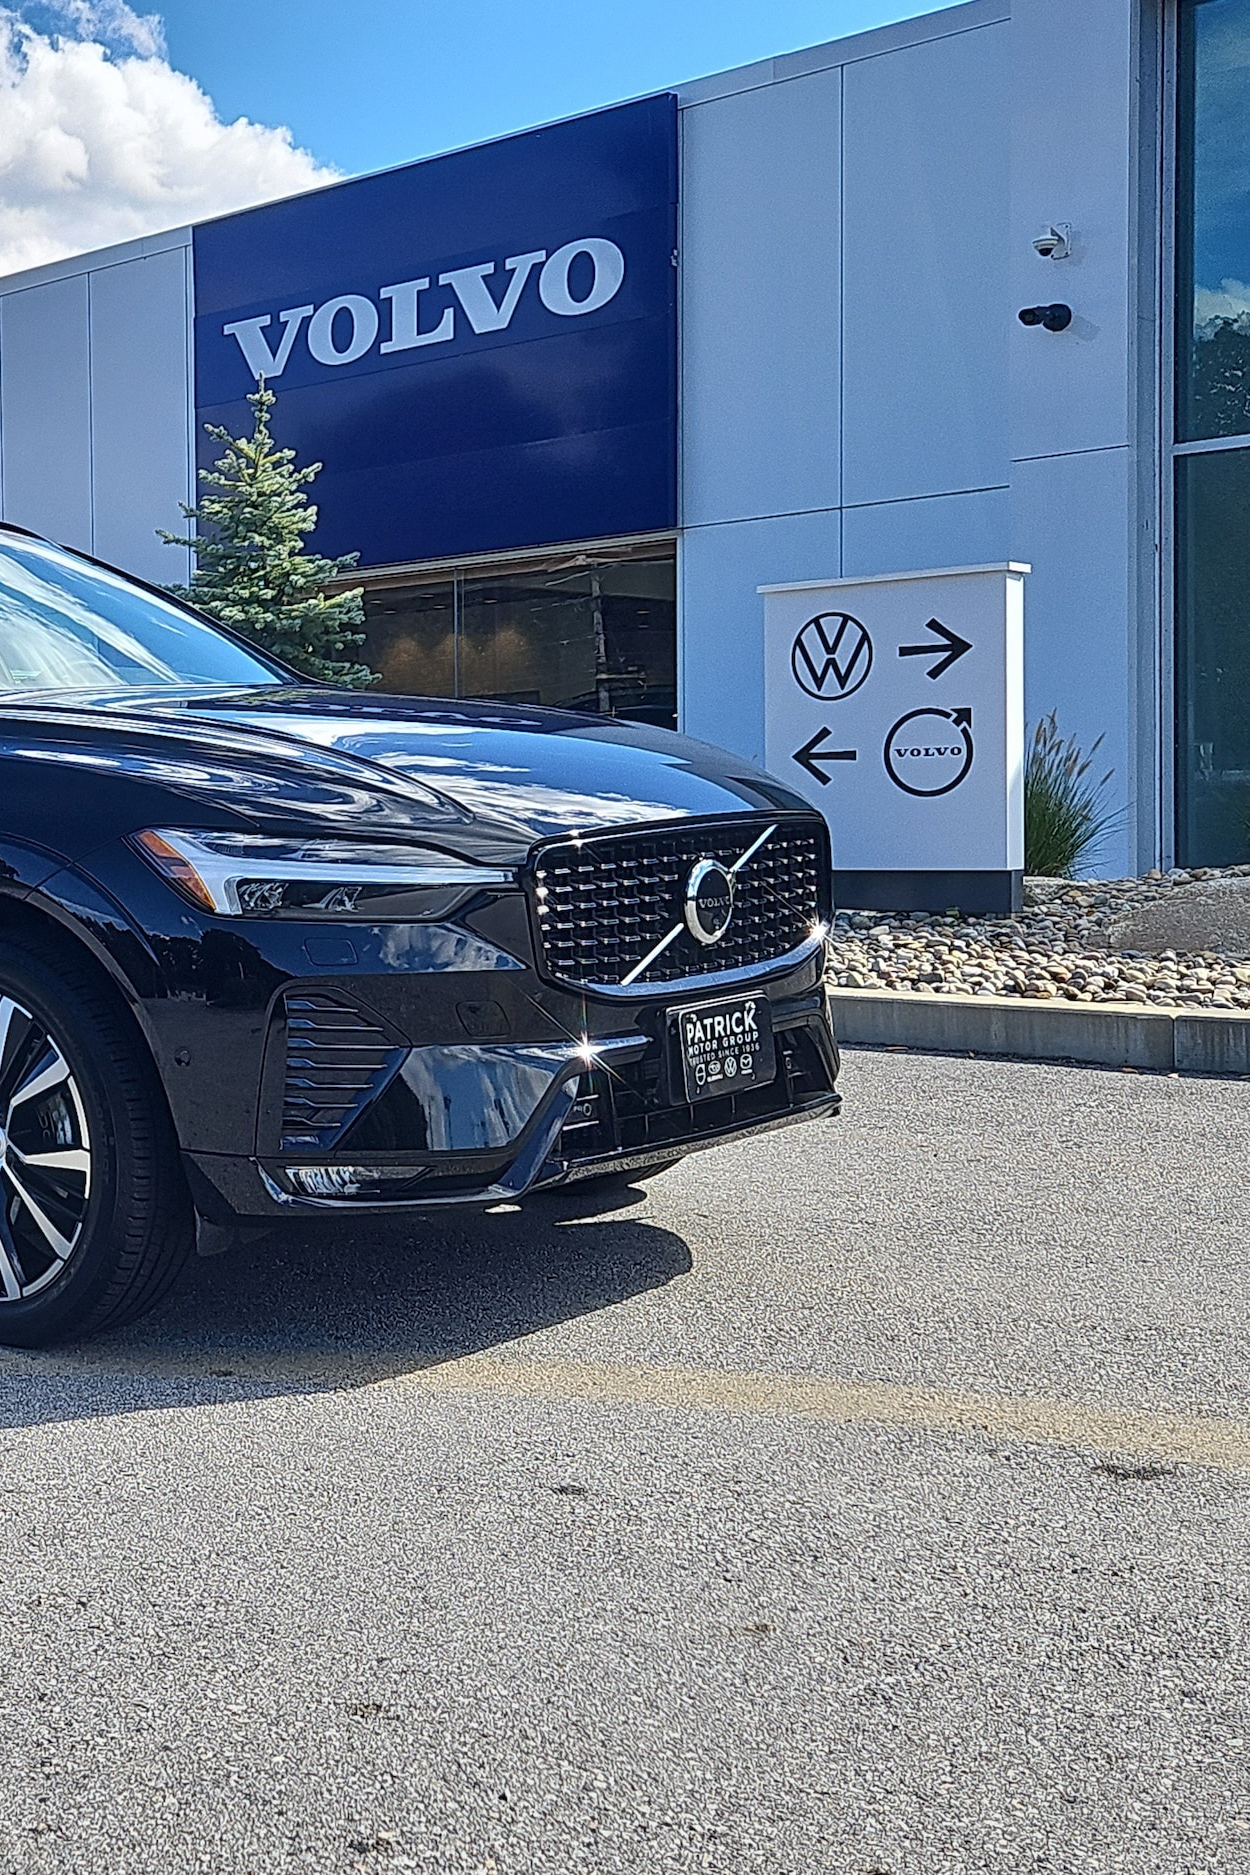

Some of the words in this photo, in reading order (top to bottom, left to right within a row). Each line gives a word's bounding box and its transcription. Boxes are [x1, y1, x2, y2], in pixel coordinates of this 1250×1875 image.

[223, 237, 626, 379] VOLVO
[893, 745, 962, 758] VOLVO
[686, 1008, 758, 1046] PATRICK
[688, 1040, 718, 1056] MOTOR
[722, 1031, 759, 1048] GROUP
[718, 1046, 740, 1059] SINCE
[742, 1042, 760, 1053] 1936
